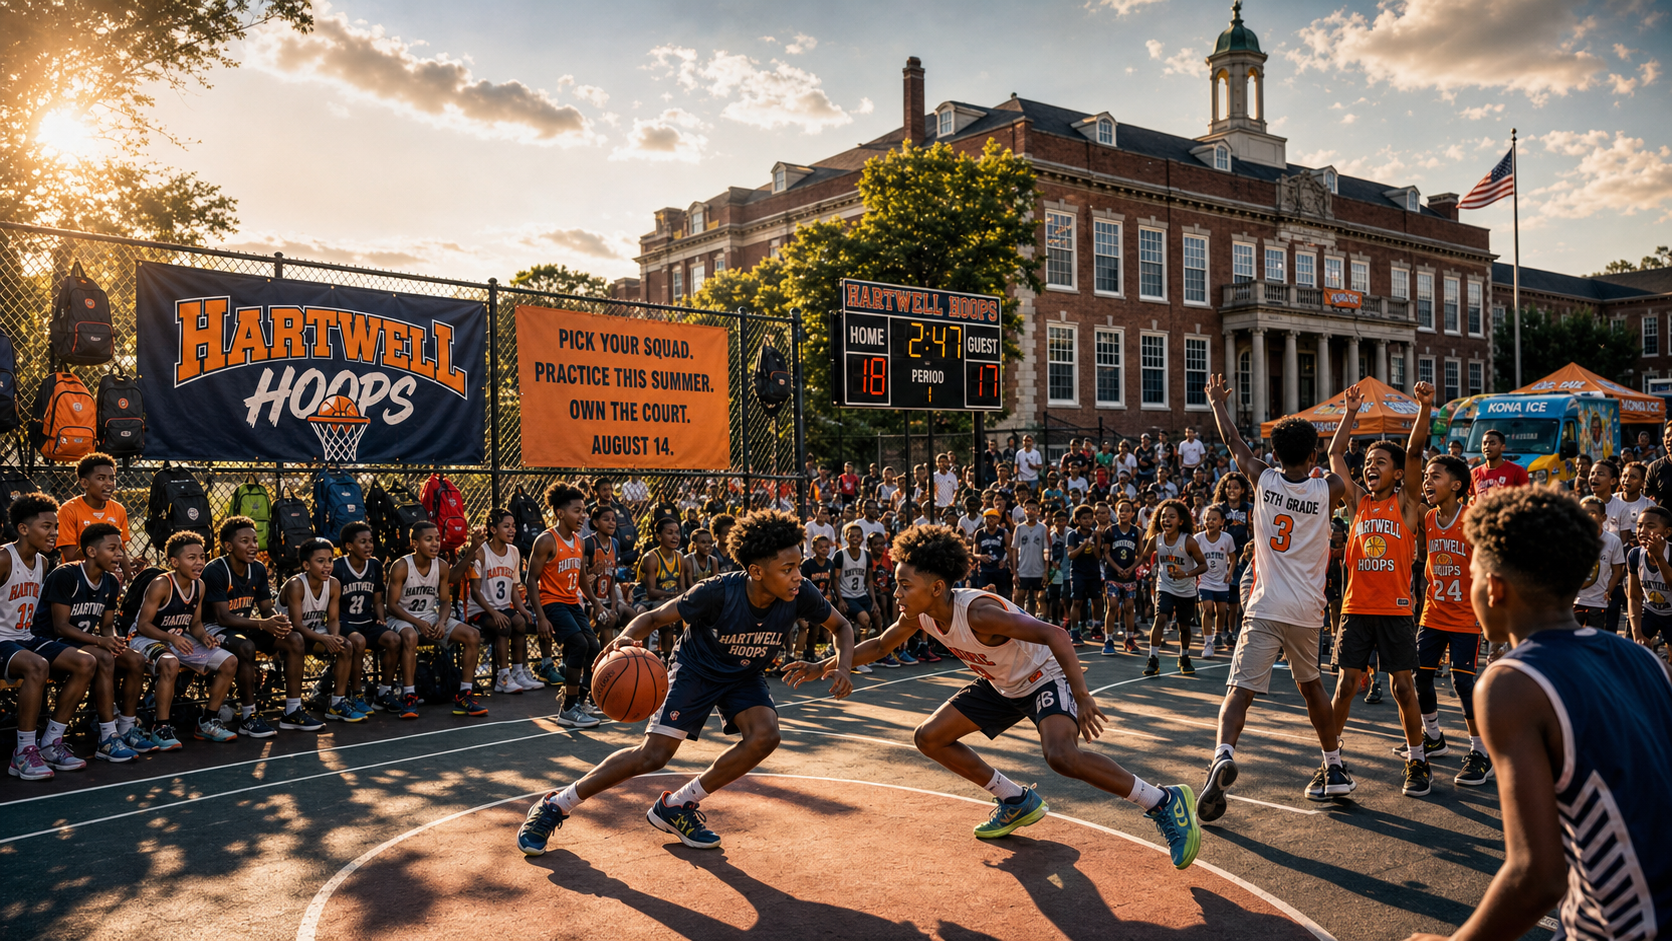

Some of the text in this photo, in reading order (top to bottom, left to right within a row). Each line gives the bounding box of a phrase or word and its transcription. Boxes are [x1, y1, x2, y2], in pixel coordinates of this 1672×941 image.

[847, 284, 998, 322] HARTWELL HOOPS
[559, 328, 694, 359] PICK YOUR SQUAD.
[850, 325, 885, 346] HOME
[908, 322, 962, 359] 2:47
[967, 336, 998, 355] GUEST
[174, 296, 468, 400] HARTWELL
[535, 362, 714, 393] PRACTICE THIS SUMMER.
[863, 357, 886, 396] 18
[911, 369, 944, 384] PERIOD
[978, 364, 998, 398] 17
[569, 399, 691, 424] OWN THE COURT.
[1487, 402, 1548, 413] KONA ICE
[591, 435, 675, 456] AUGUST 14.
[1286, 497, 1319, 515] GRADE
[1269, 513, 1294, 553] 3
[1357, 559, 1395, 572] HOOPS
[496, 580, 505, 600] 3
[1433, 579, 1462, 602] 24
[719, 631, 783, 646] HARTWELL
[728, 645, 768, 658] HOOPS
